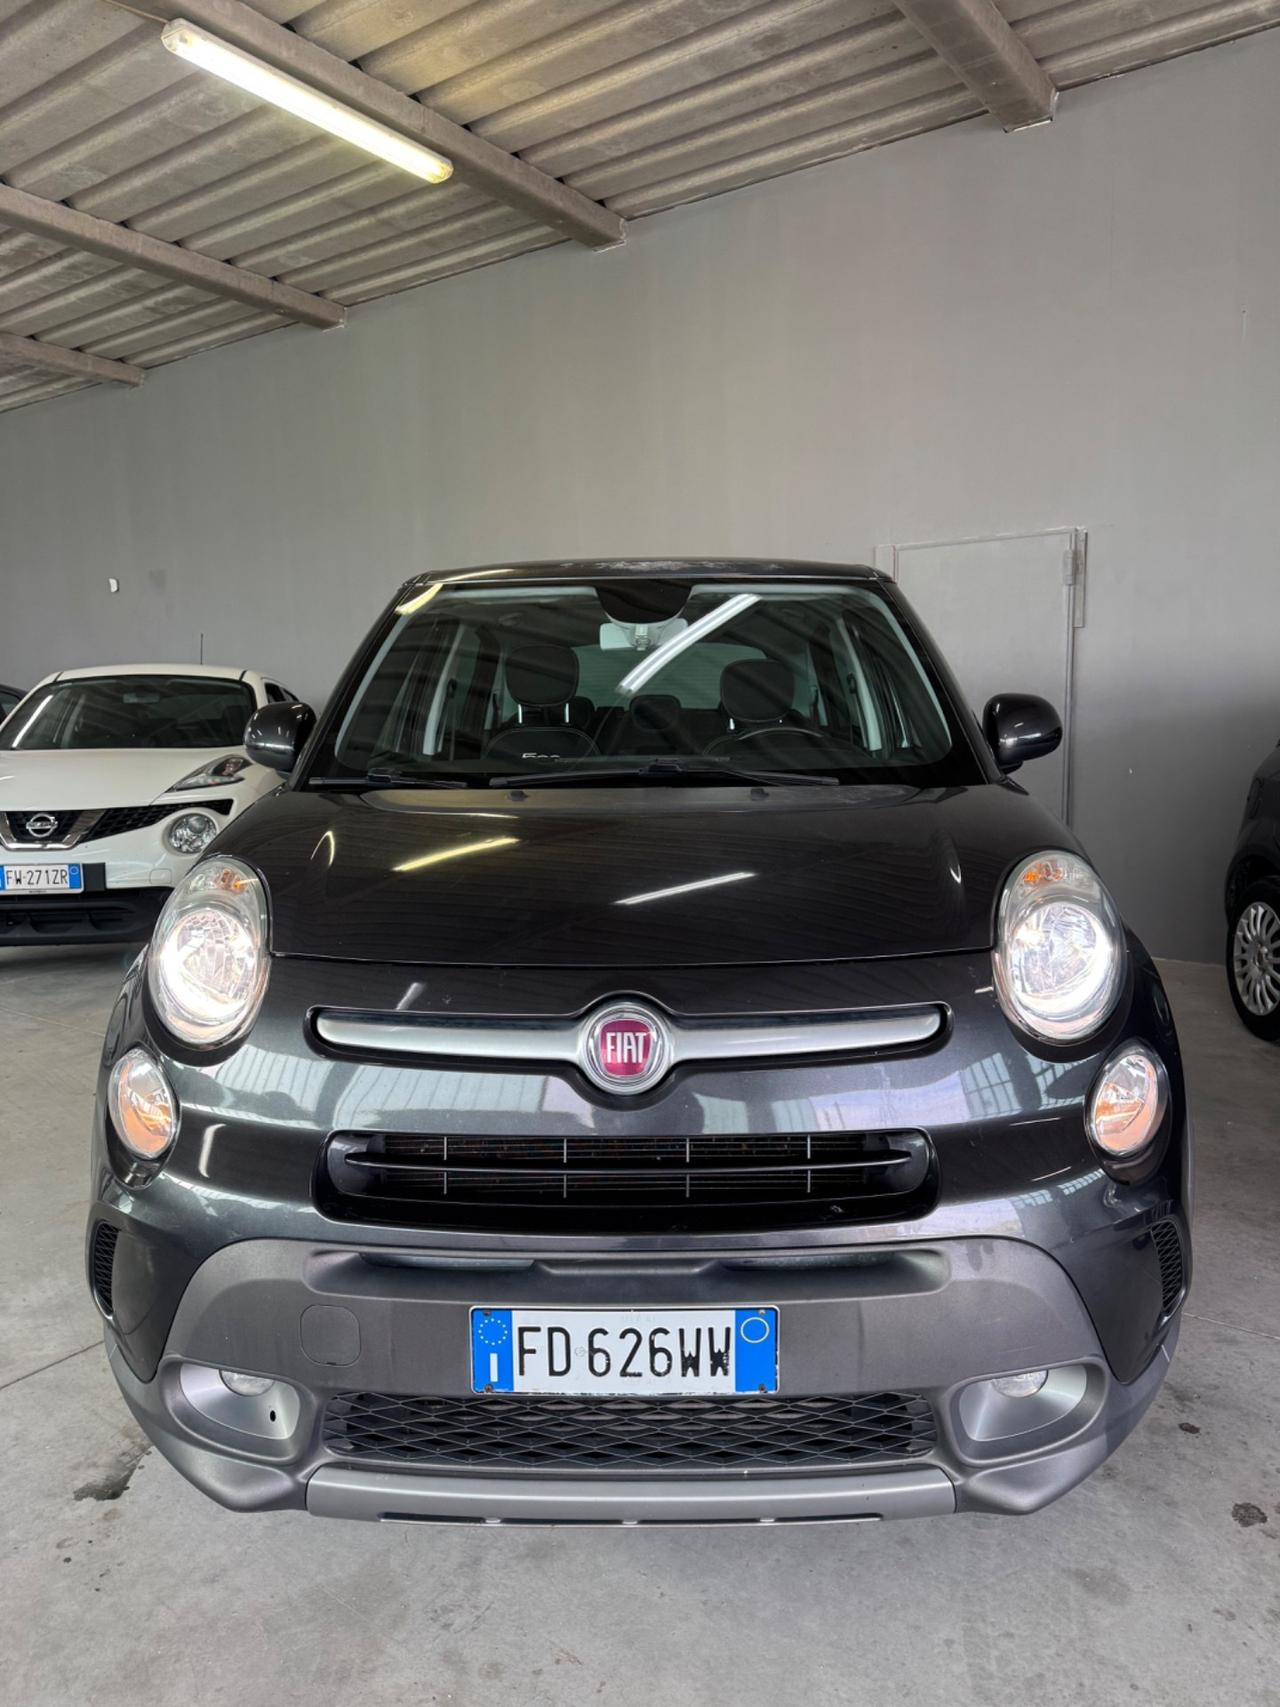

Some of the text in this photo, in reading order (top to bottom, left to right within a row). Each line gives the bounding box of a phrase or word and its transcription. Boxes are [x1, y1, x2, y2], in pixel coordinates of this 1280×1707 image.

[606, 1031, 647, 1064] FIAT
[517, 1326, 731, 1378] FD 626WW
